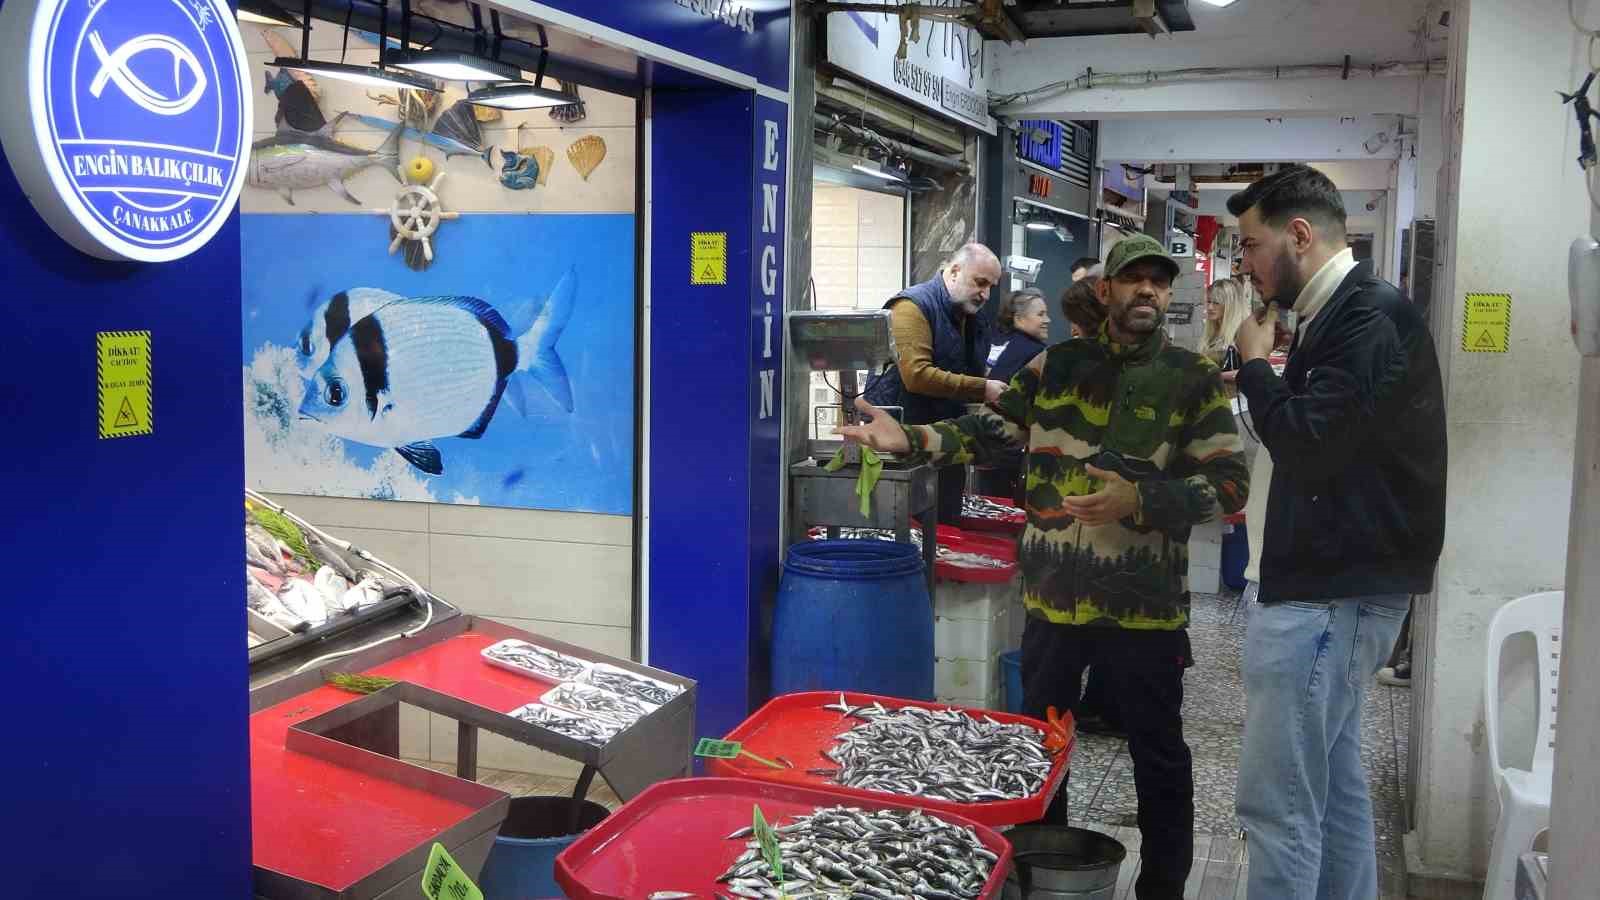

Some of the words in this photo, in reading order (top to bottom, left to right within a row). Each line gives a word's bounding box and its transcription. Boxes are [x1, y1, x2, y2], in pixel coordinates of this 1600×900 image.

[73, 148, 128, 176] ENGİN
[131, 155, 224, 187] BALIKÇILIK
[112, 205, 194, 232] ÇANAKKALE
[1171, 242, 1187, 254] B
[759, 119, 780, 420] ENGİN
